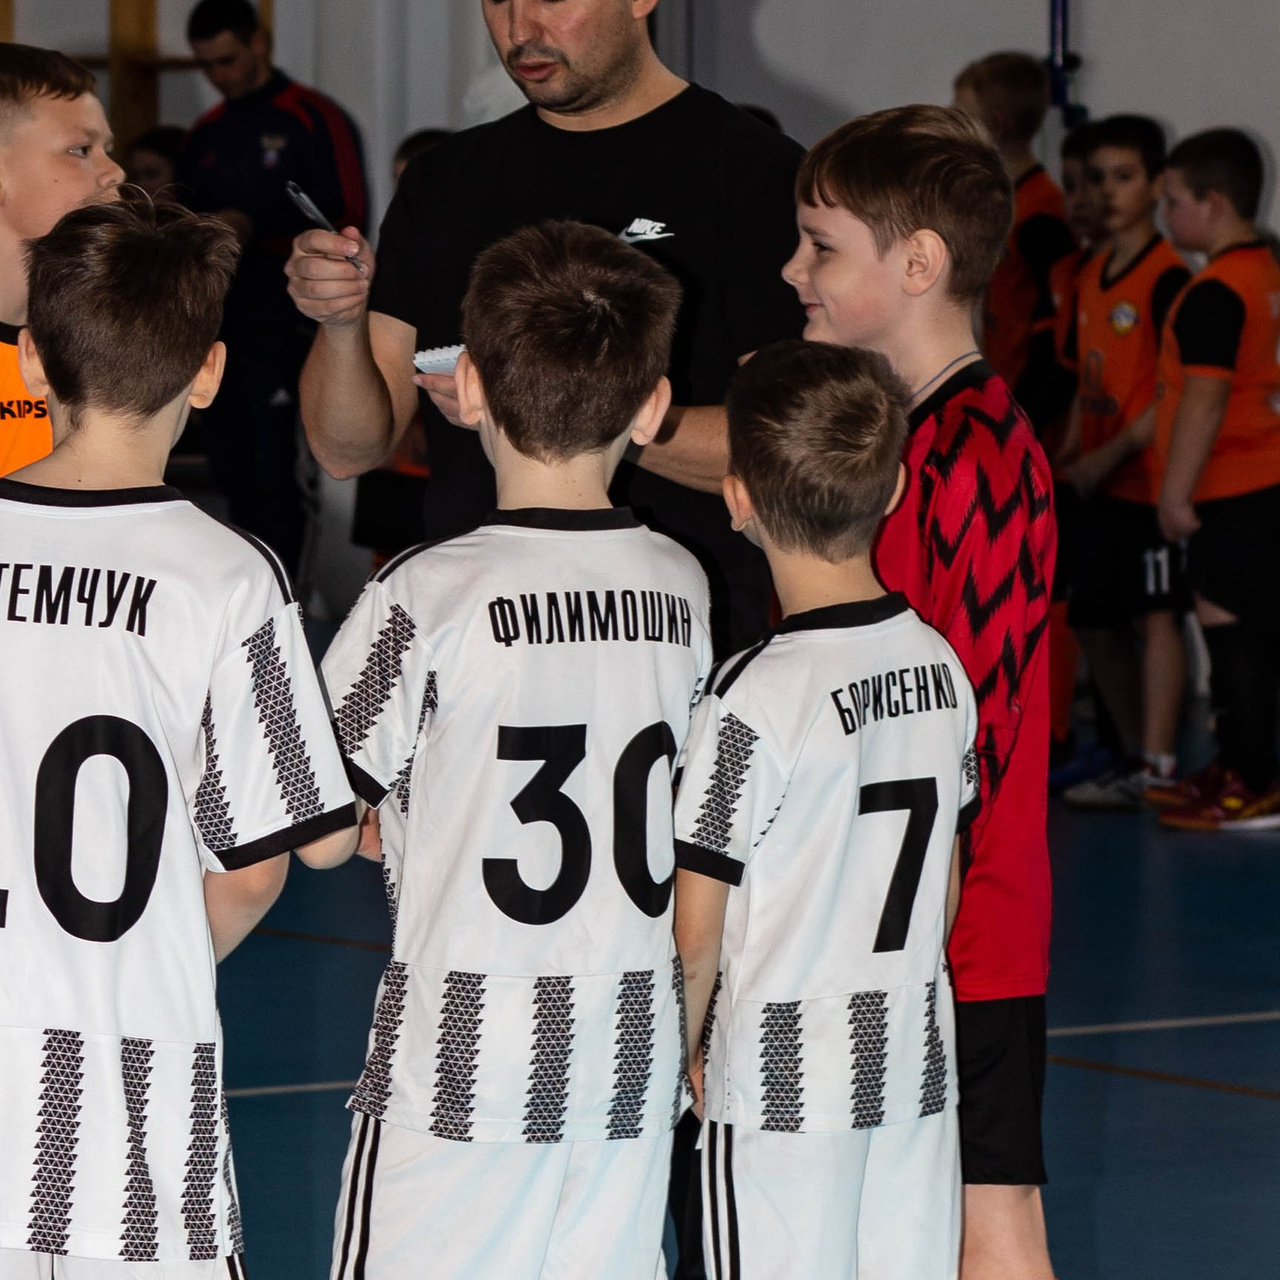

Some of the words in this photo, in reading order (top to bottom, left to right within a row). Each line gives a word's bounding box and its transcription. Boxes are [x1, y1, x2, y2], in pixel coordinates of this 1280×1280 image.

[487, 589, 693, 649] ФИЛИМОШИН
[482, 720, 677, 926] 30
[857, 776, 939, 954] 7
